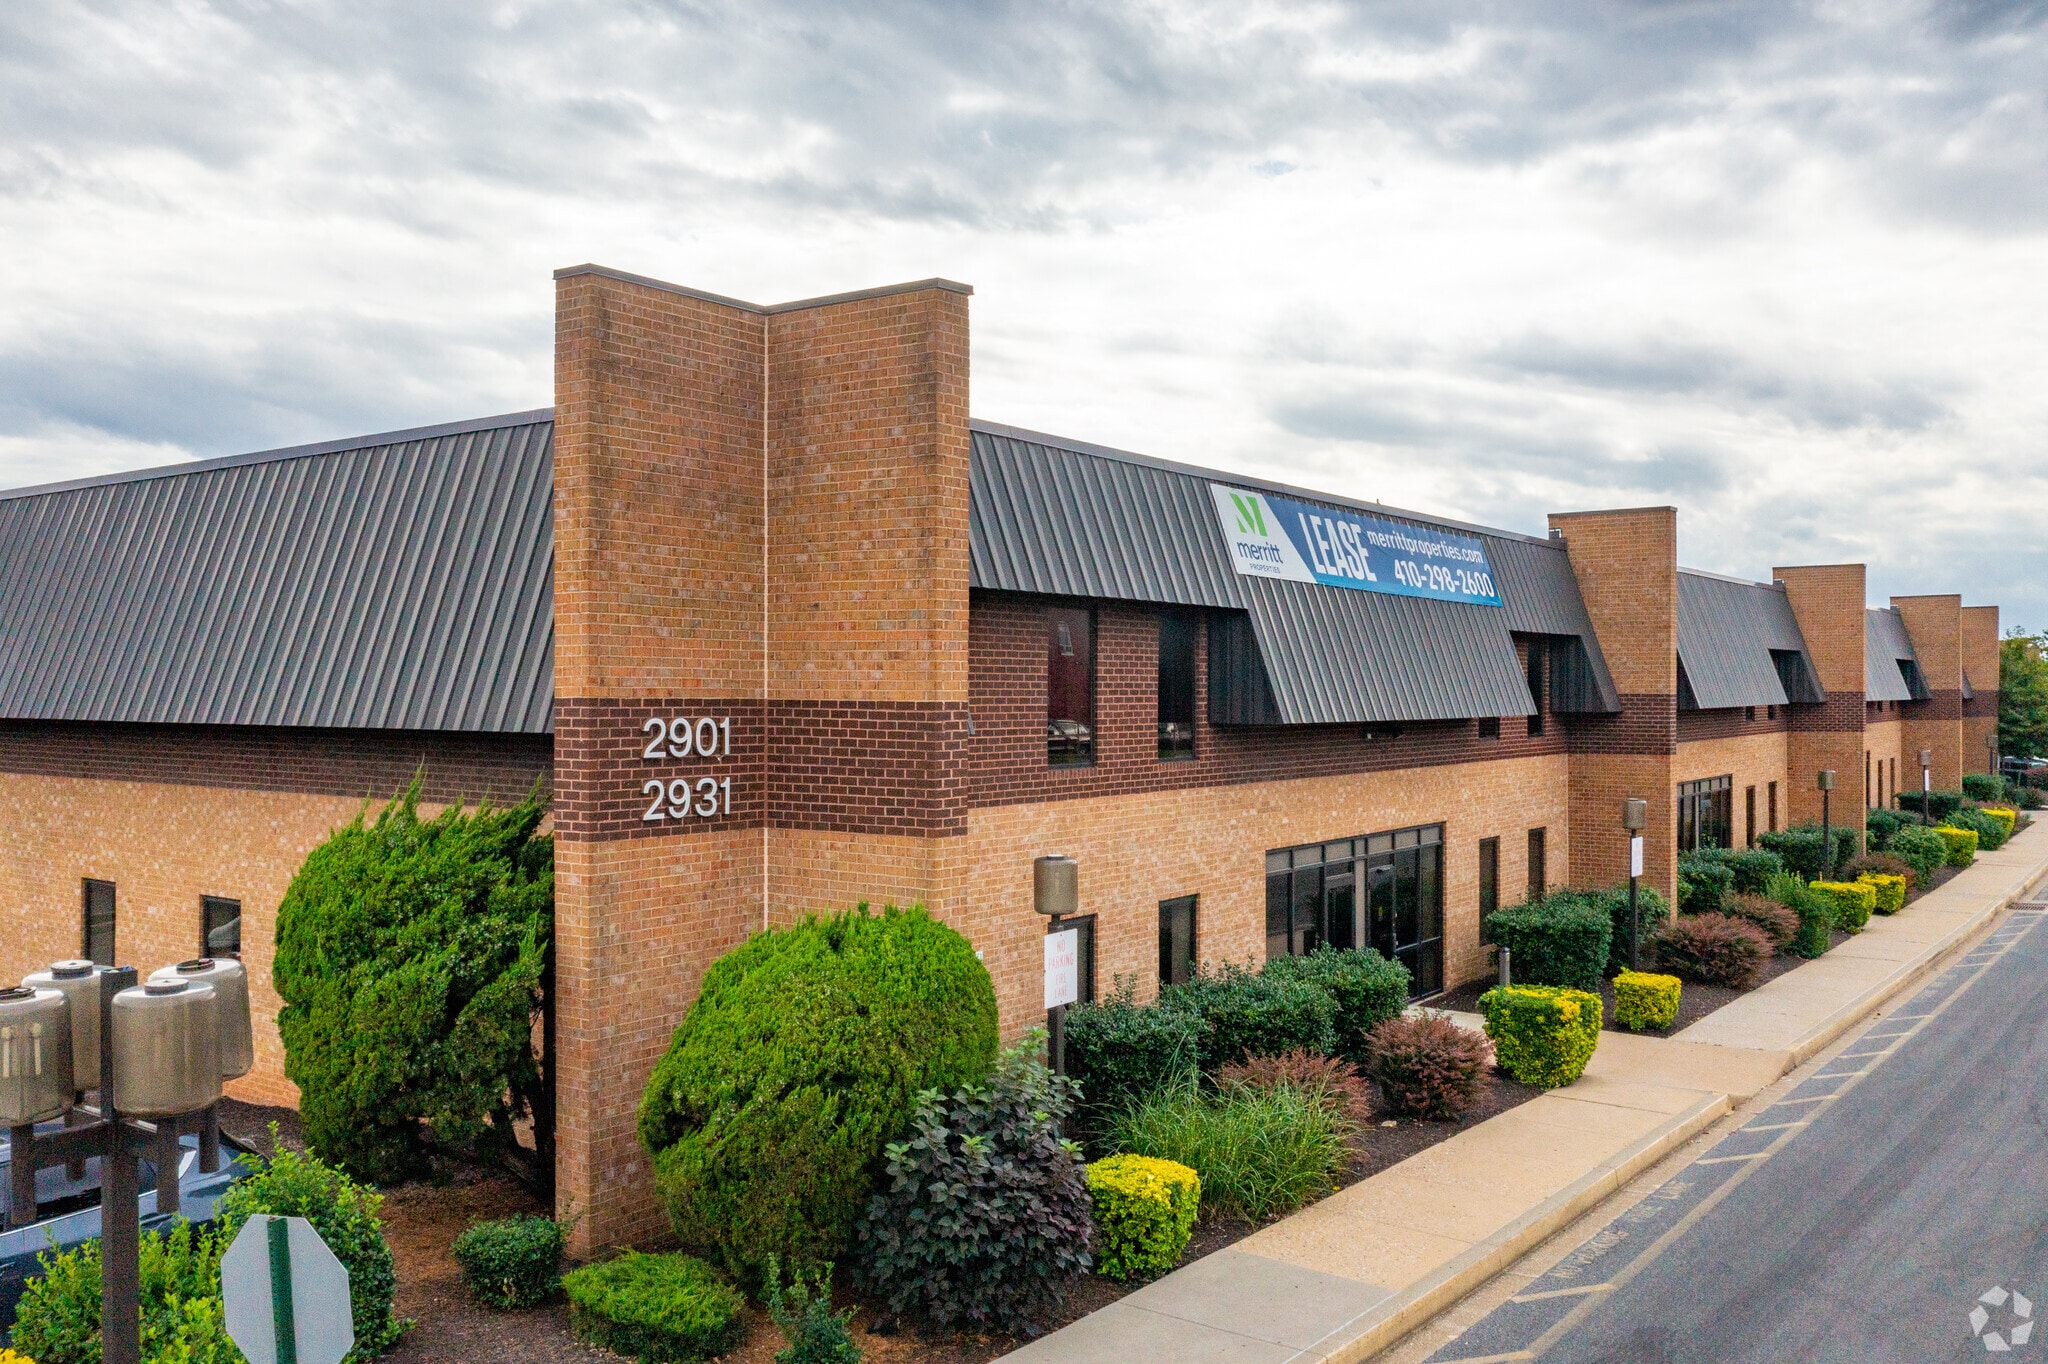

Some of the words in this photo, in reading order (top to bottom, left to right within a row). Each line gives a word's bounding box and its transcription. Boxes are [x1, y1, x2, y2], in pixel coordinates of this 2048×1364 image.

[1236, 541, 1284, 564] merritt
[1298, 512, 1377, 582] LEASE
[1366, 529, 1484, 564] merrittproperties.com
[1249, 563, 1281, 574] PROPERTIES
[1394, 559, 1495, 598] 410-298-2600
[642, 716, 730, 758] 2901
[642, 776, 731, 821] 2931
[1057, 939, 1066, 953] NO
[1049, 952, 1074, 970] PARKING
[1056, 972, 1067, 985] FIRE
[1055, 985, 1068, 999] LANE
